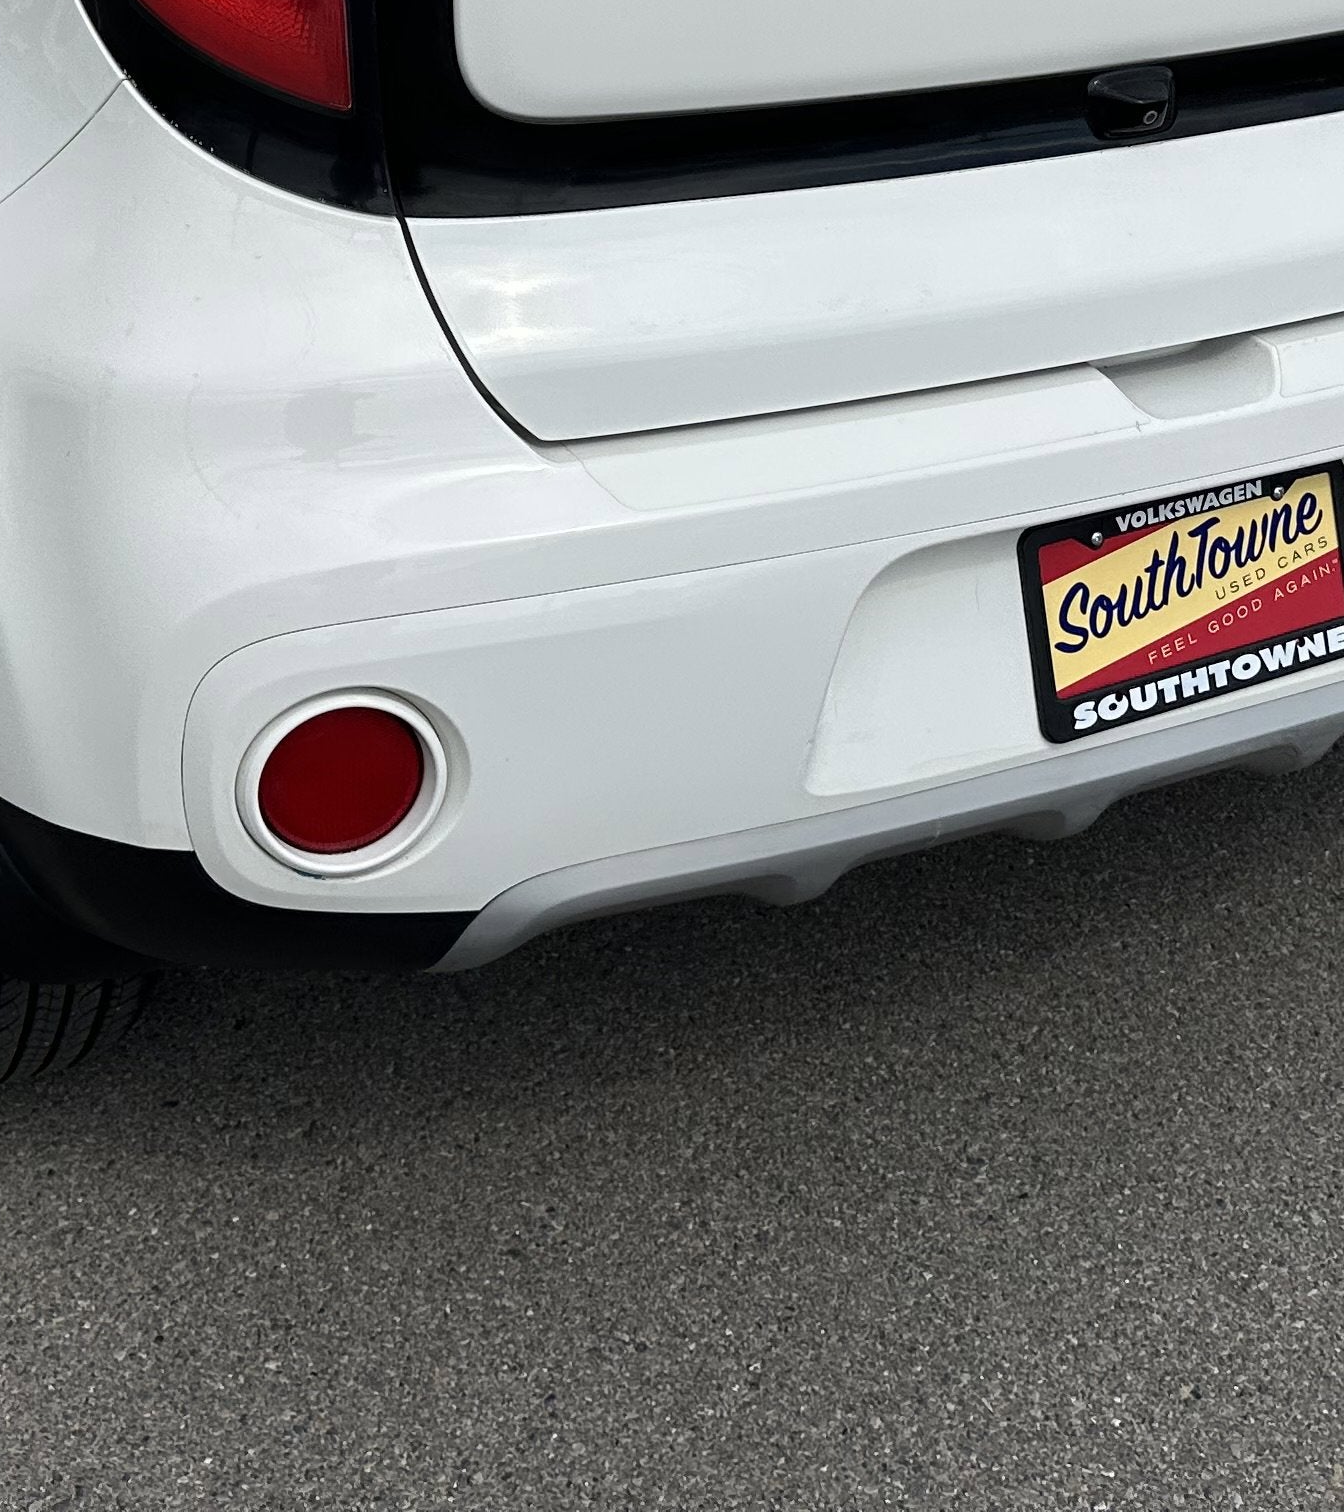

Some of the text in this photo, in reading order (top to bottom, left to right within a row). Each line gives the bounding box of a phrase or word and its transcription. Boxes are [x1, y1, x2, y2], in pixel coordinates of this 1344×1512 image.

[1115, 480, 1263, 532] VOLKSWAGEN
[1215, 535, 1328, 600] USED CARS
[1147, 635, 1198, 664] FEEL
[1207, 598, 1262, 634] GOOD
